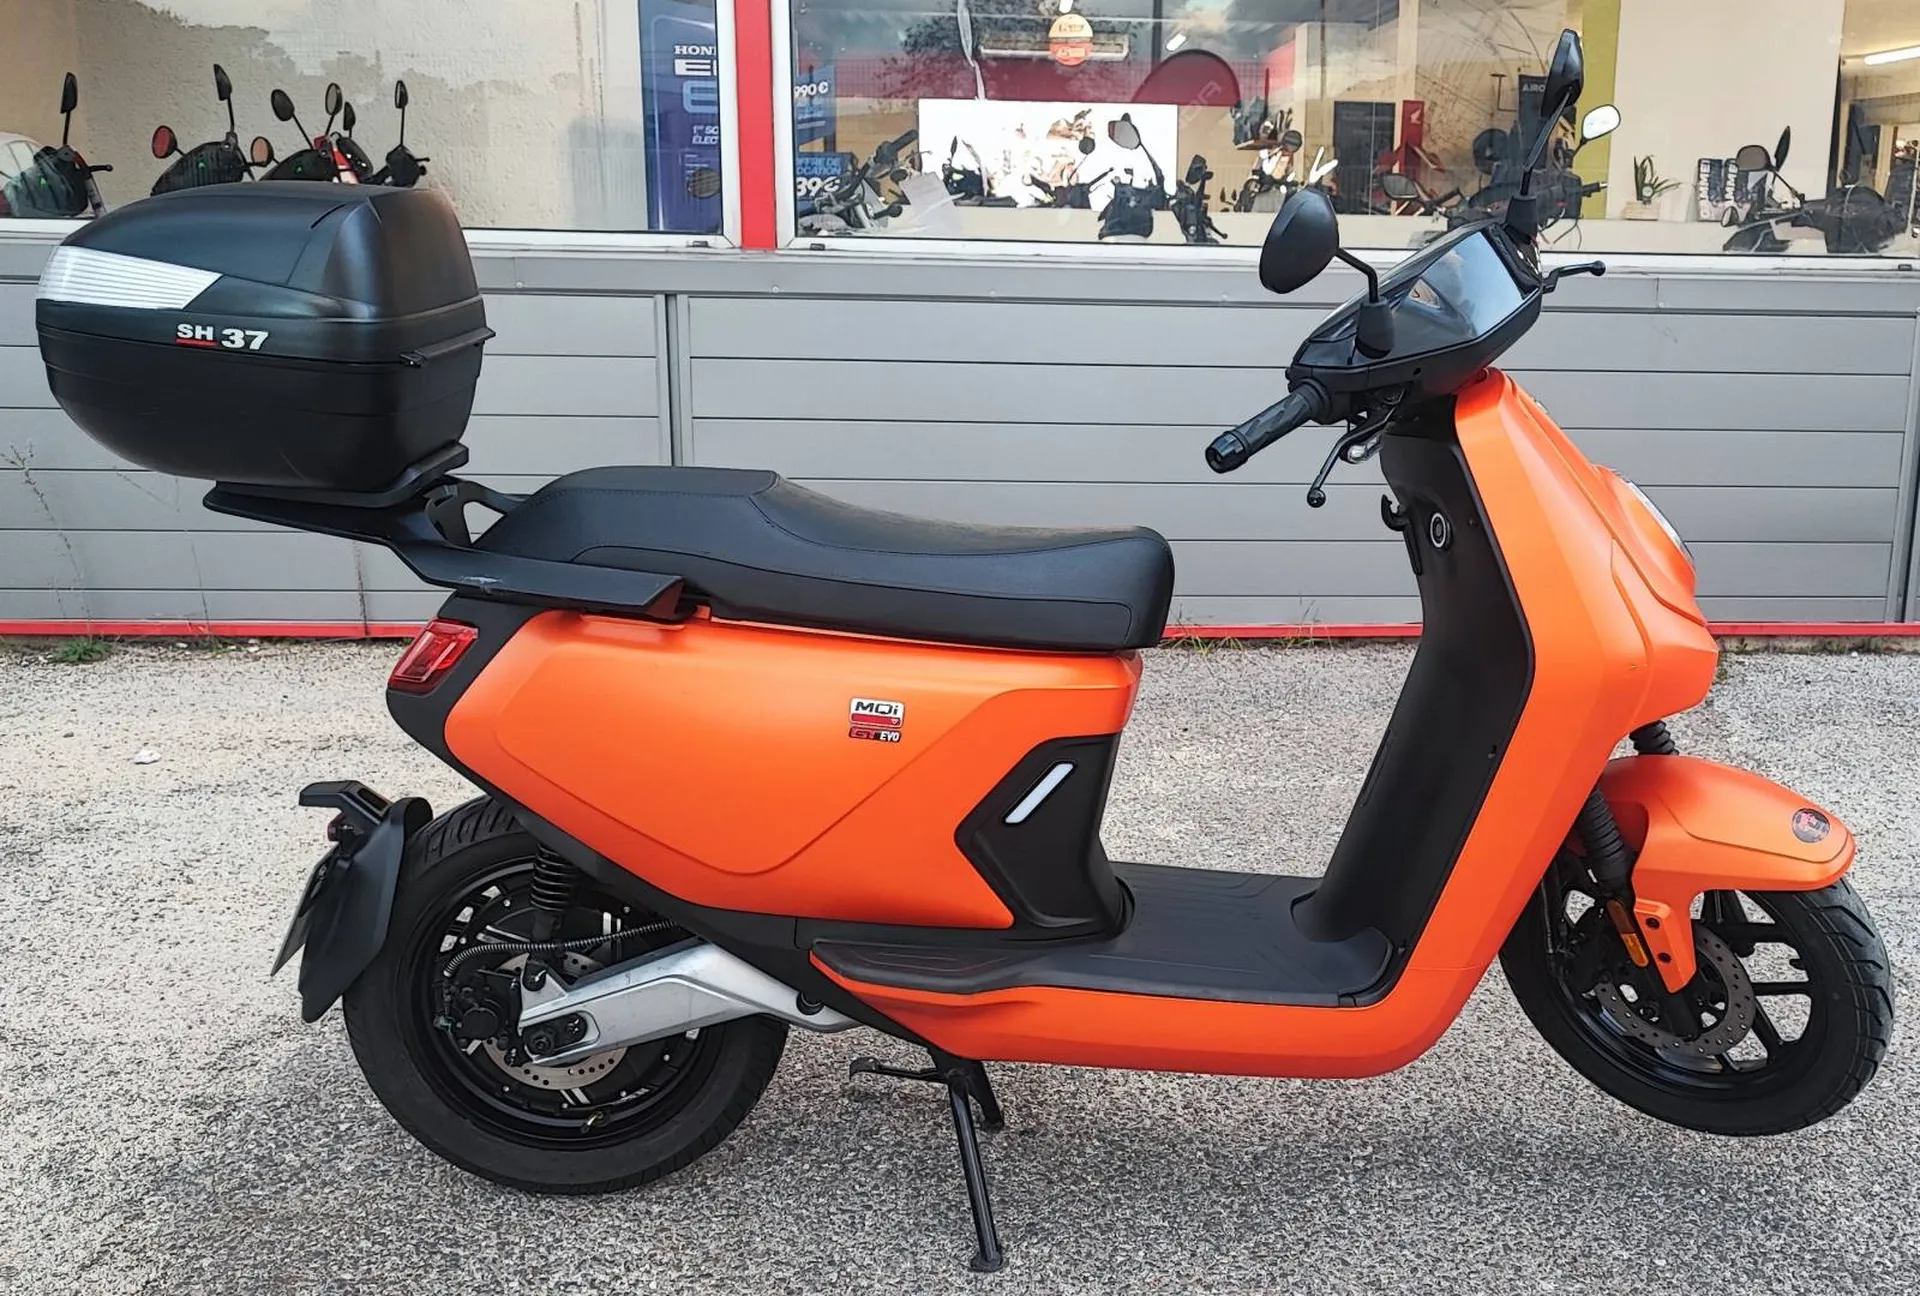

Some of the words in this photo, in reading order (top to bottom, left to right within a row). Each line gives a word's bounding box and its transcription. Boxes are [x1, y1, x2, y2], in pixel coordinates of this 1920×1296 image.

[177, 323, 214, 341] SH
[221, 328, 269, 350] 37
[855, 701, 899, 716] MQi
[879, 731, 900, 743] EVO
